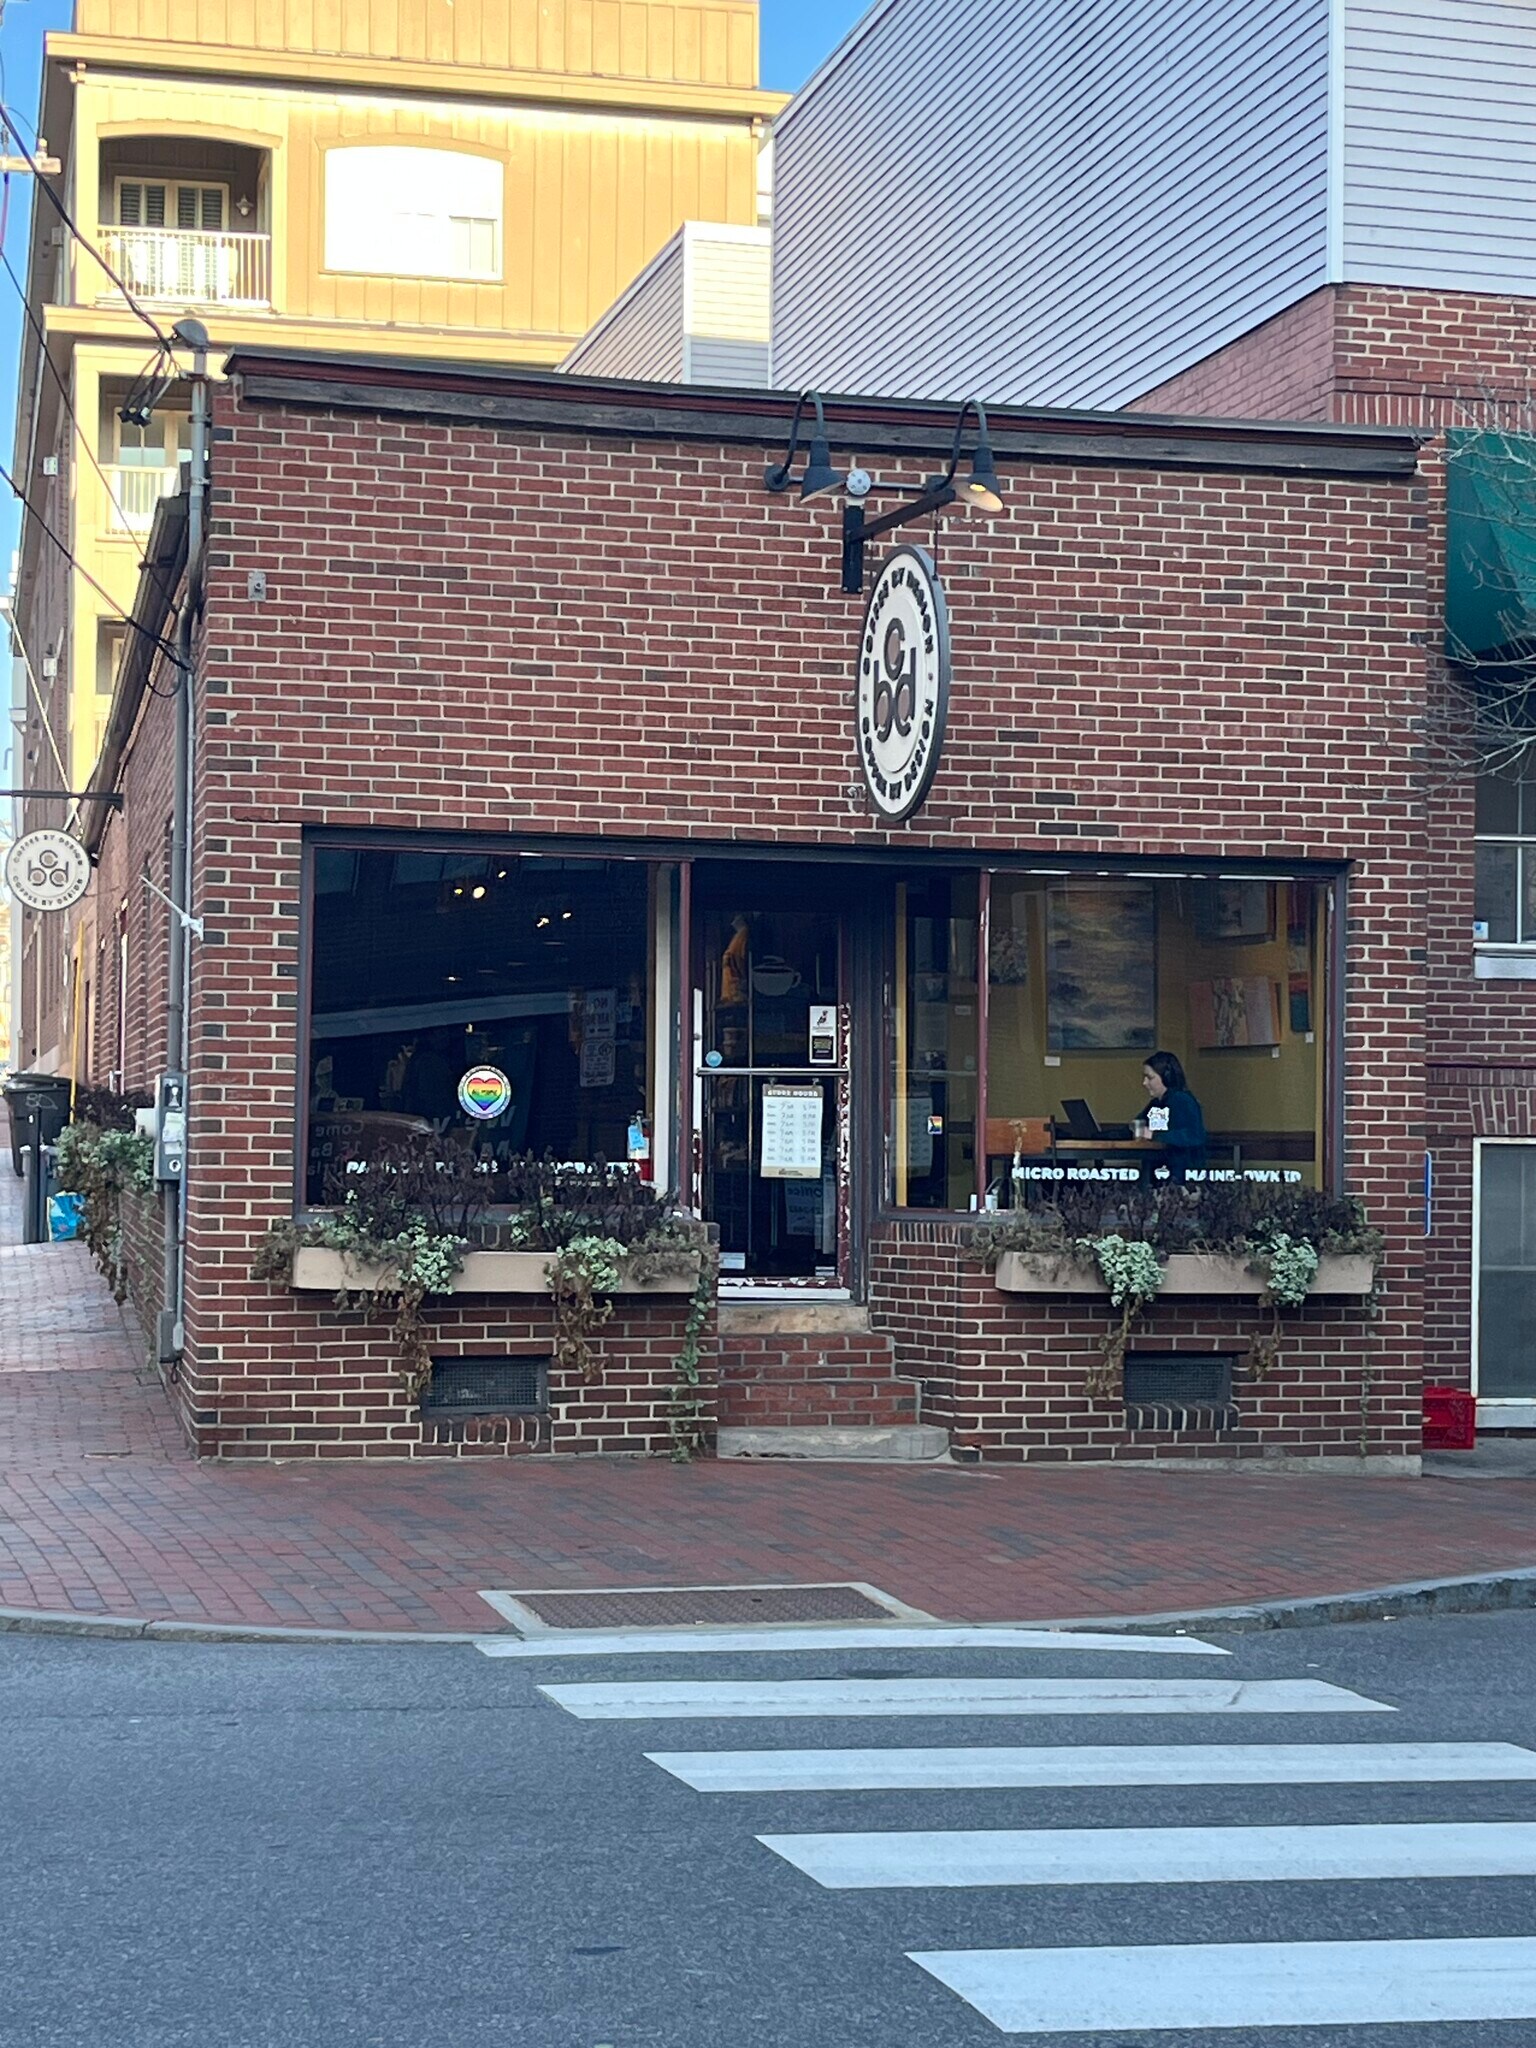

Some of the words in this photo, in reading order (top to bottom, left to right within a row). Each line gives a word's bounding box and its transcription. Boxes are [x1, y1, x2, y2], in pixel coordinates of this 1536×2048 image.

[863, 579, 889, 676] COFFEE
[891, 566, 906, 589] BY
[907, 570, 934, 654] DESIGN
[862, 716, 888, 797] COFFEE
[904, 698, 934, 792] DESIGN
[13, 835, 39, 864] COFFEE
[12, 875, 38, 904] COFFEE
[1011, 1166, 1065, 1181] MICRO
[1067, 1167, 1140, 1182] ROASTED
